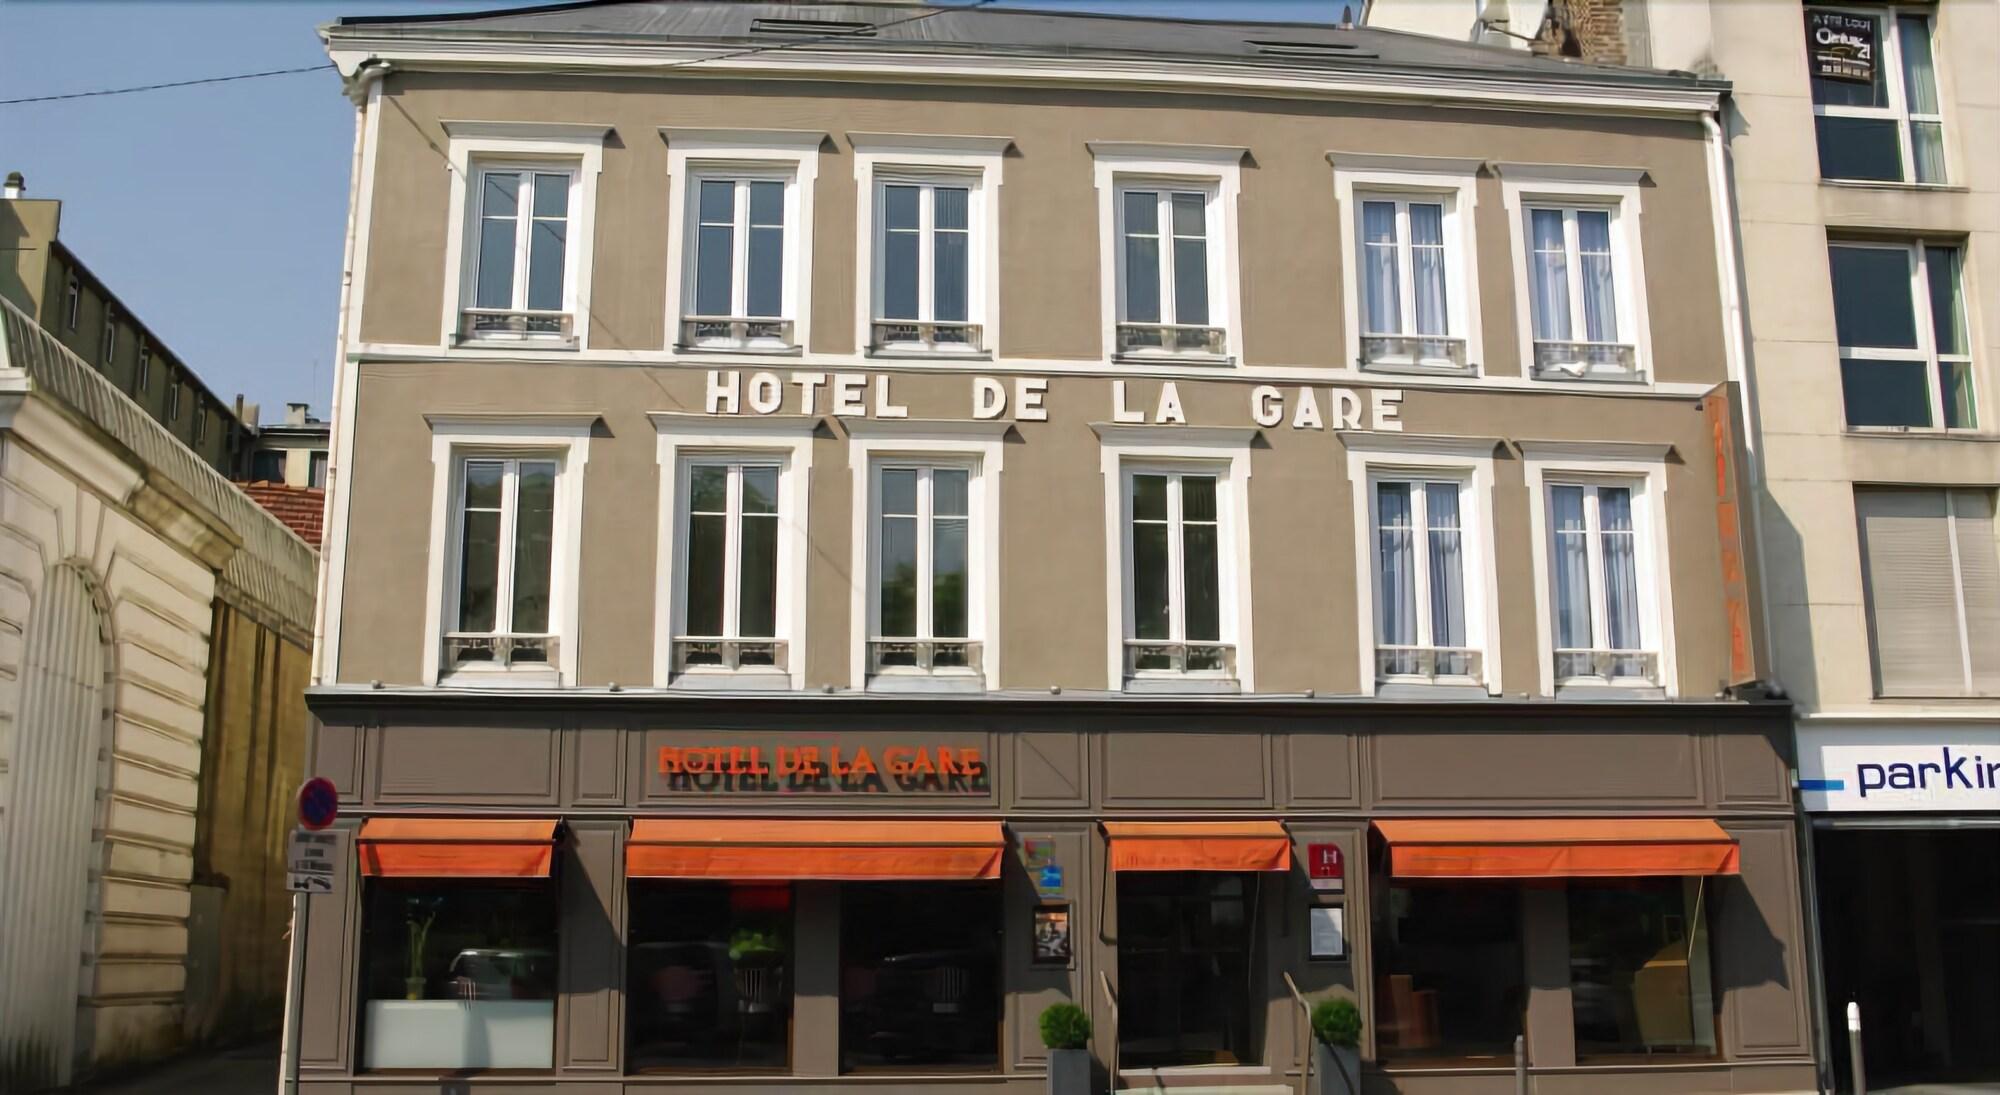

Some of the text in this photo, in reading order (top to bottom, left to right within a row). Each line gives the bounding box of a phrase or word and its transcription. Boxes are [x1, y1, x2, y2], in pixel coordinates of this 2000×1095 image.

[705, 370, 1404, 432] HOTEL DE LA GARE
[657, 746, 981, 776] HOTEL DE LA GARE
[1323, 849, 1337, 864] H
